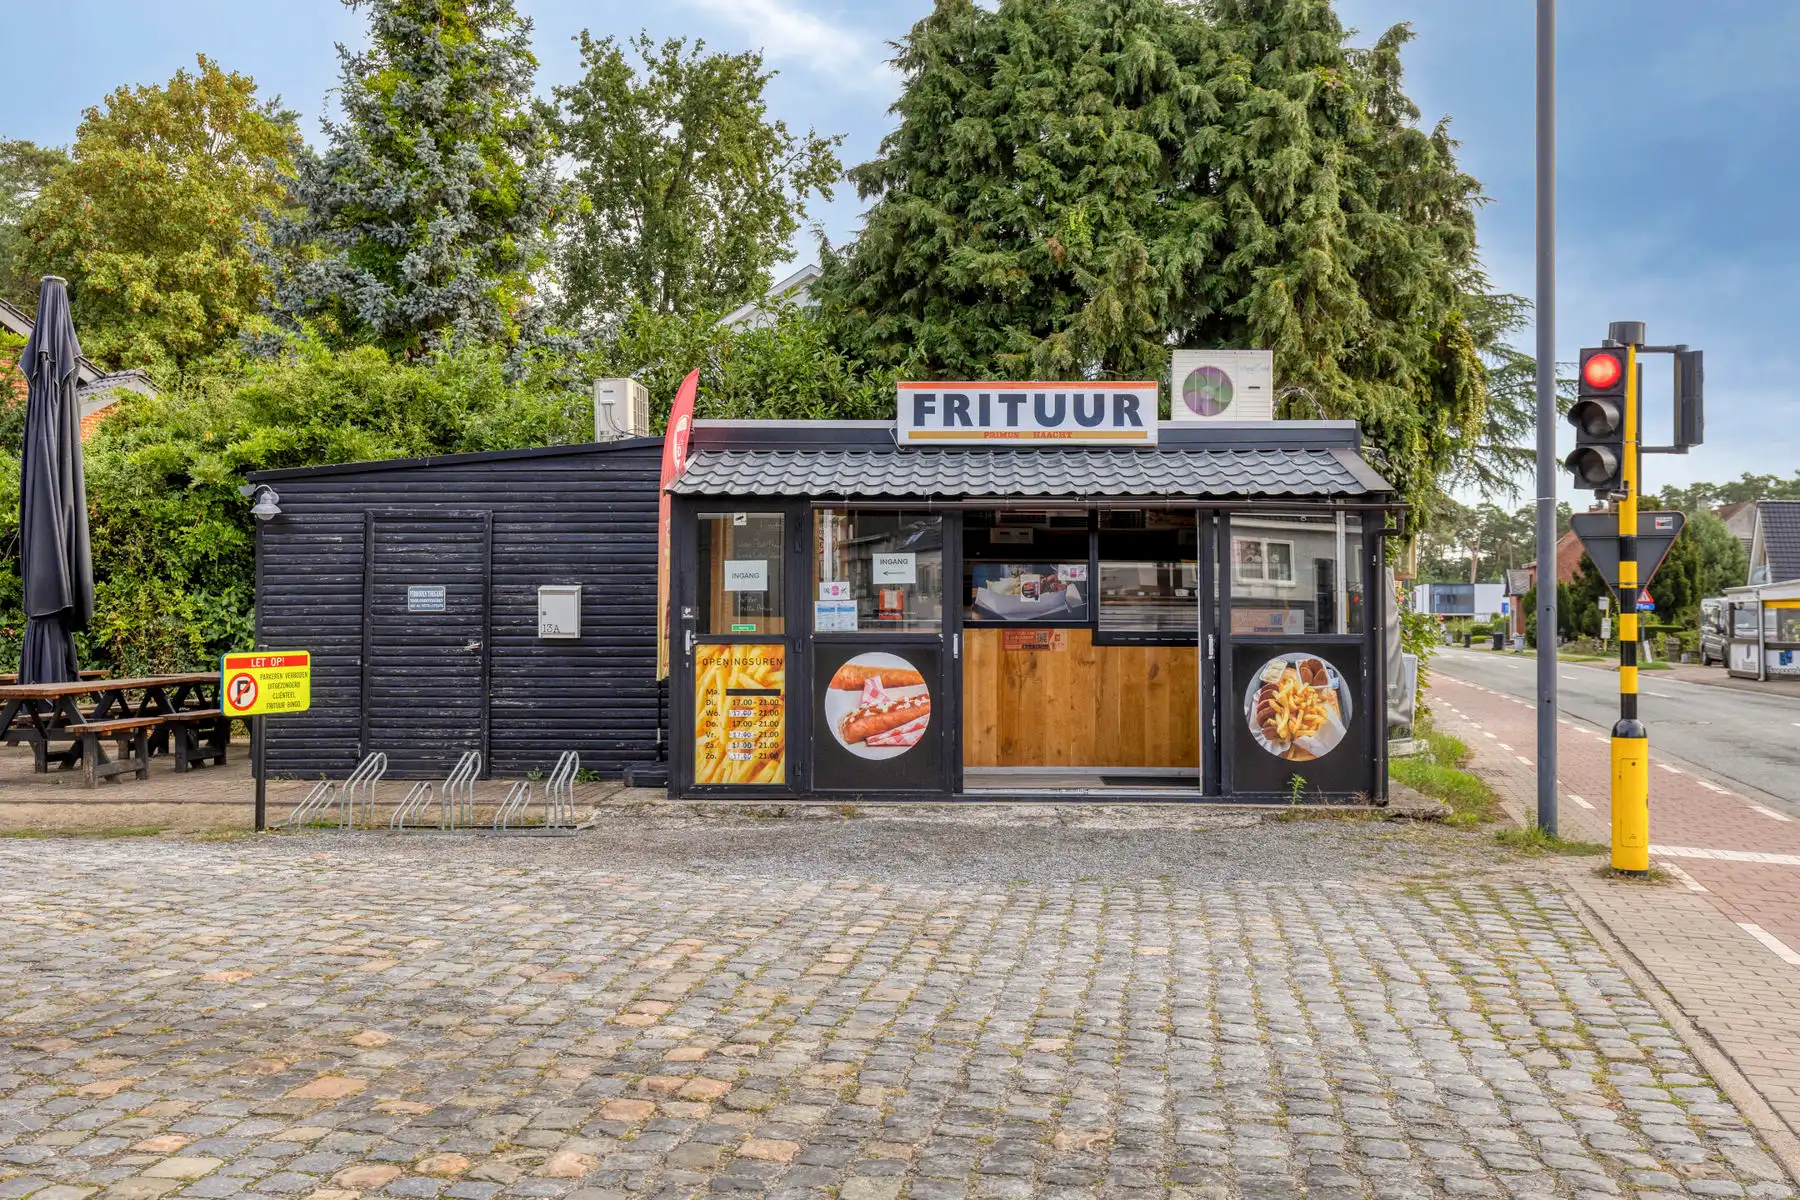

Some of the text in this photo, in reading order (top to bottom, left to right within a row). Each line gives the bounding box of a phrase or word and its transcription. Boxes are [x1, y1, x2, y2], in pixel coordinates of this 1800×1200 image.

[913, 393, 1143, 427] FRITUUR
[984, 431, 1072, 439] PRIMUS HAACHT
[543, 624, 560, 633] 13A
[251, 657, 285, 668] LET OP!
[702, 658, 783, 666] OPENINGSUREN
[260, 671, 308, 680] PARKEREN VERBODEN
[268, 682, 300, 690] UITGEZONDERD
[266, 702, 285, 710] FRITUUR
